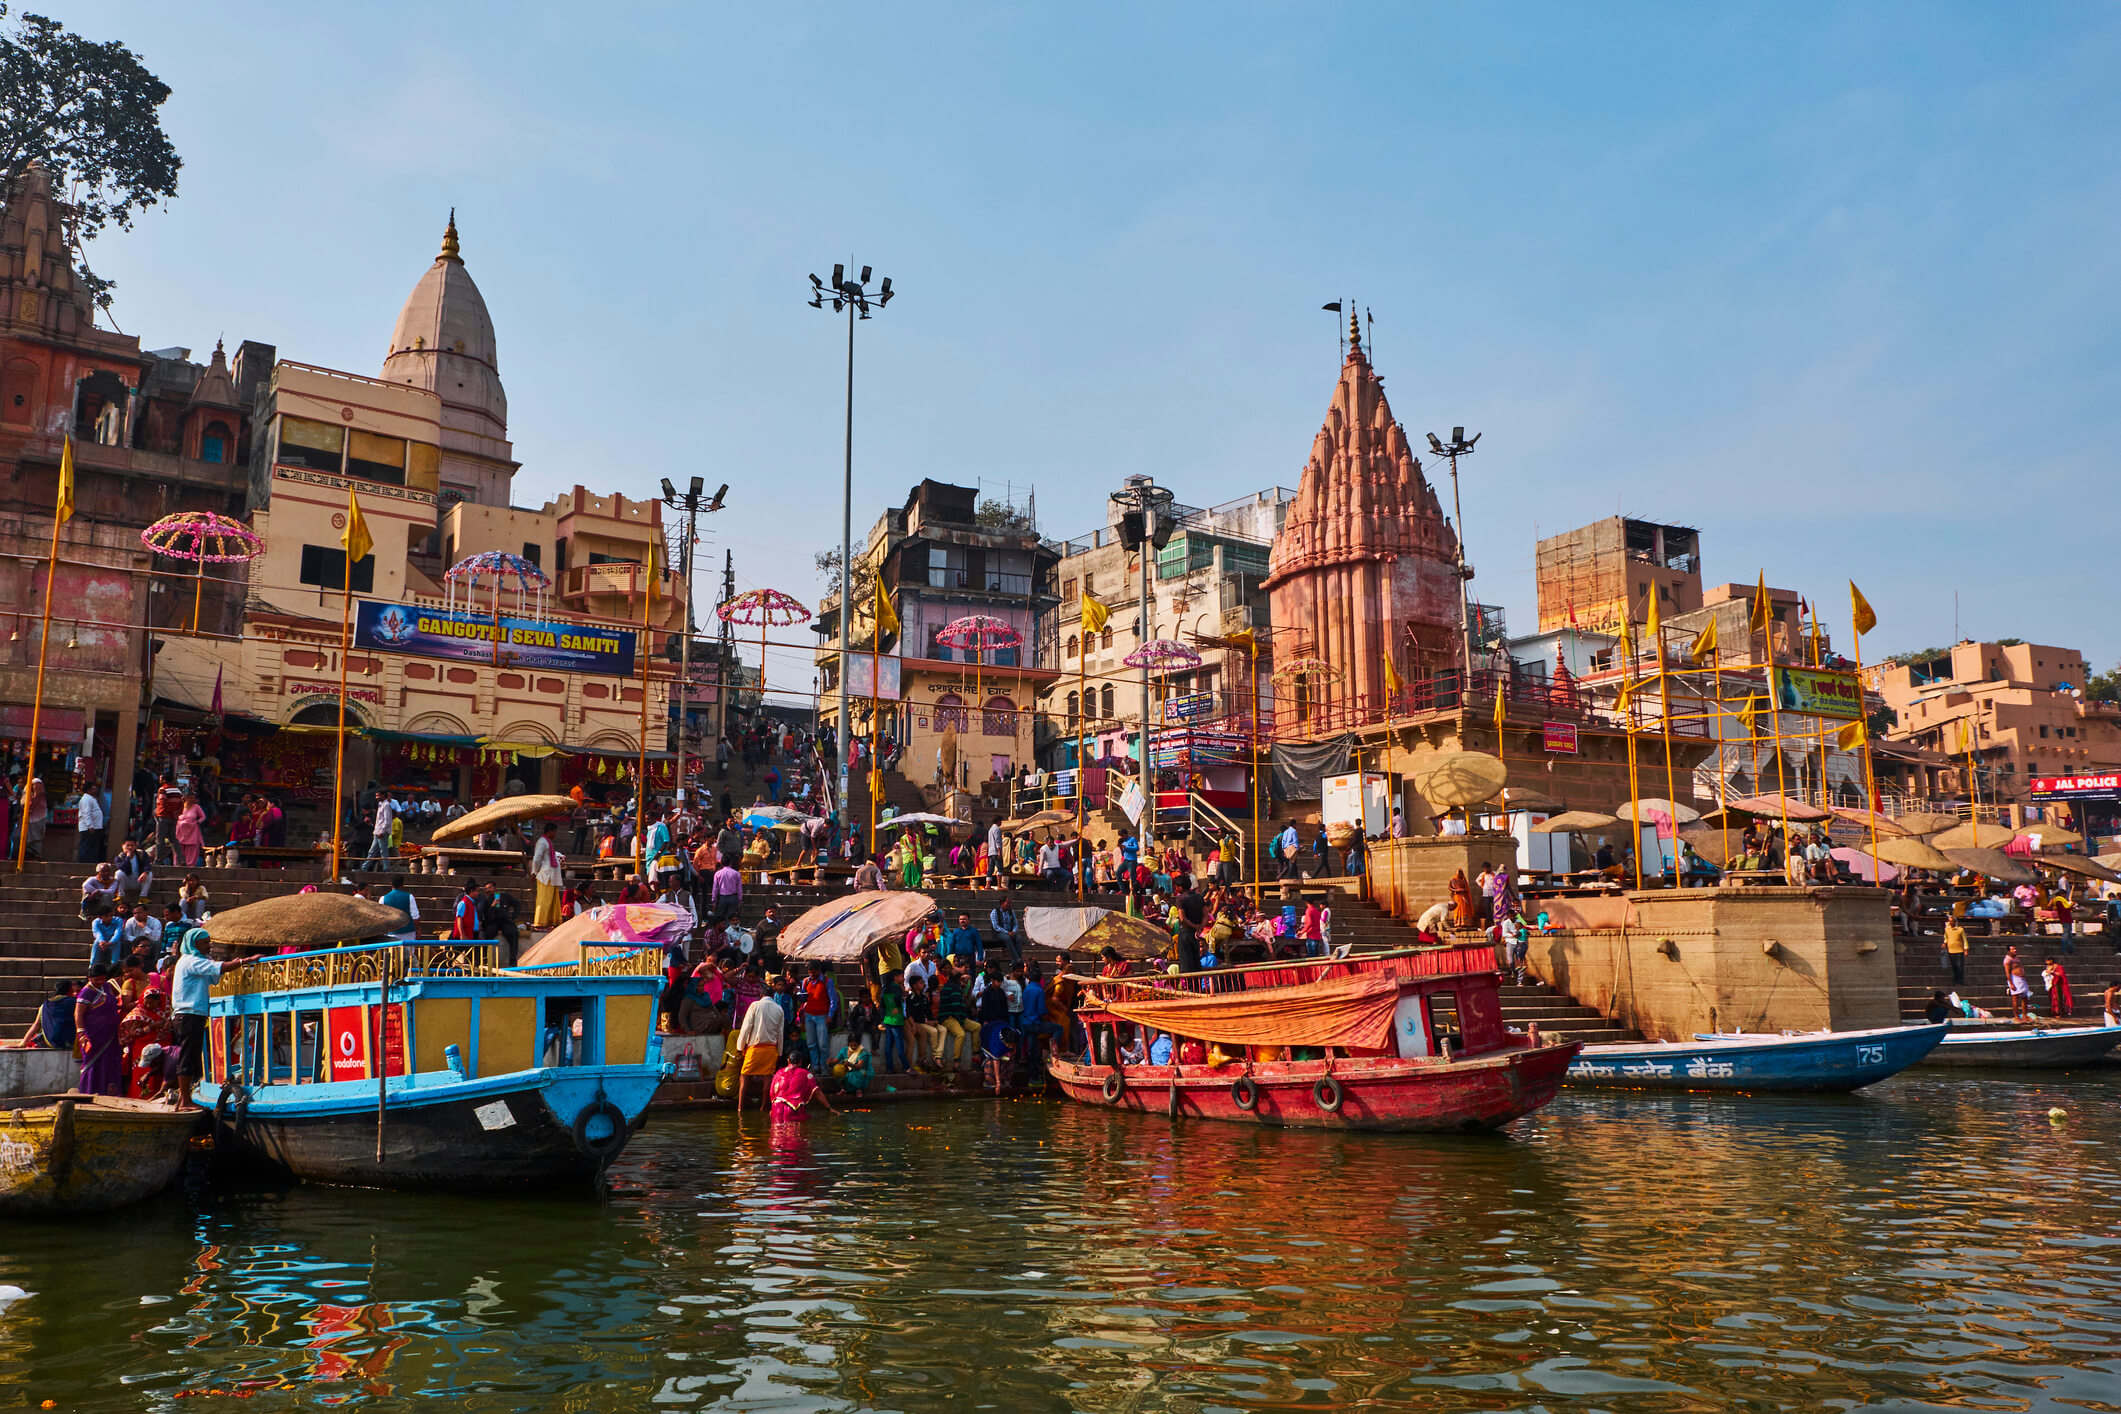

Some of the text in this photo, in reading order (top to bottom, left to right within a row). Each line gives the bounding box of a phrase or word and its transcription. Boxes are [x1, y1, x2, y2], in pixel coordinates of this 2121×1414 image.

[418, 617, 507, 643] GANGOTRI
[512, 628, 556, 648] SEVA
[560, 634, 620, 654] SAMITI
[2055, 777, 2117, 789] JAL POLICE
[334, 1058, 366, 1068] vodafone
[1859, 1046, 1883, 1064] 75
[1686, 1057, 1734, 1079] बैंक
